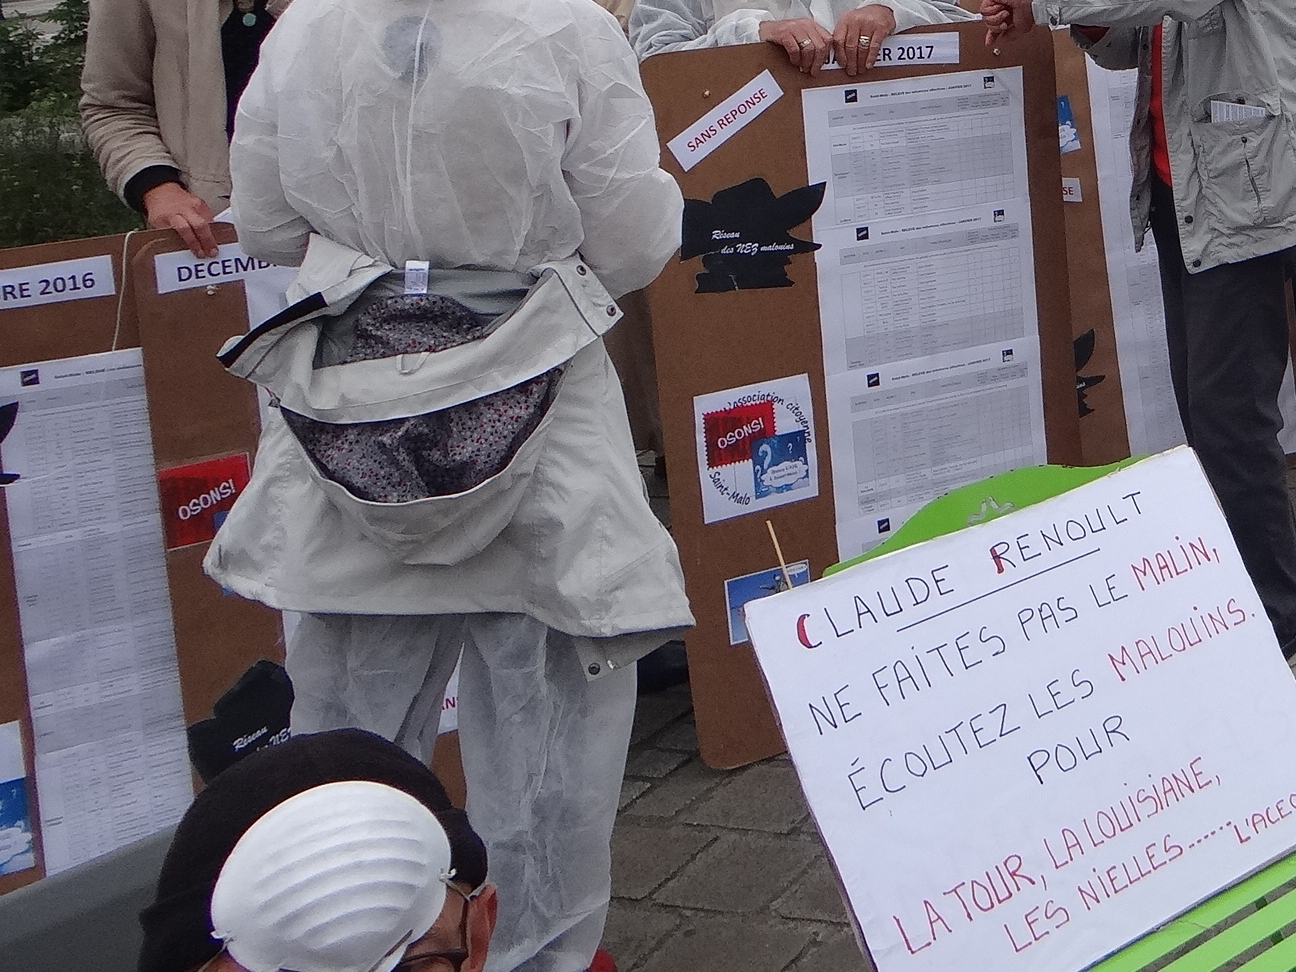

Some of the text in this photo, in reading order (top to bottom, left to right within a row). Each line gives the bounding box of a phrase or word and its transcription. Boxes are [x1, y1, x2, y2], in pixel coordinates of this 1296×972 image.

[897, 45, 934, 61] 2017
[686, 87, 769, 153] SANS REPONSE
[1062, 186, 1074, 196] SE
[710, 229, 740, 240] Réseau
[720, 242, 795, 256] des NEZ malouins
[38, 272, 96, 296] 2016
[177, 256, 278, 283] DECEMB
[717, 417, 765, 449] OSONS!
[725, 389, 812, 444] 'association citoyenne
[178, 478, 236, 521] OSONS!
[709, 471, 751, 506] Saint-Malo
[795, 490, 1143, 649] CLAUDE RENOULT
[808, 684, 863, 737] NE
[1017, 596, 1080, 642] PAS
[1089, 573, 1128, 606] LE
[233, 725, 269, 751] Réseau
[846, 701, 1022, 812] ÉCOUTEZ
[1028, 668, 1096, 719] LES
[1026, 713, 1131, 786] POUR
[893, 900, 953, 956] LA
[942, 853, 1048, 919] TOUR,
[1042, 826, 1085, 870] LA
[1003, 900, 1071, 953] LES
